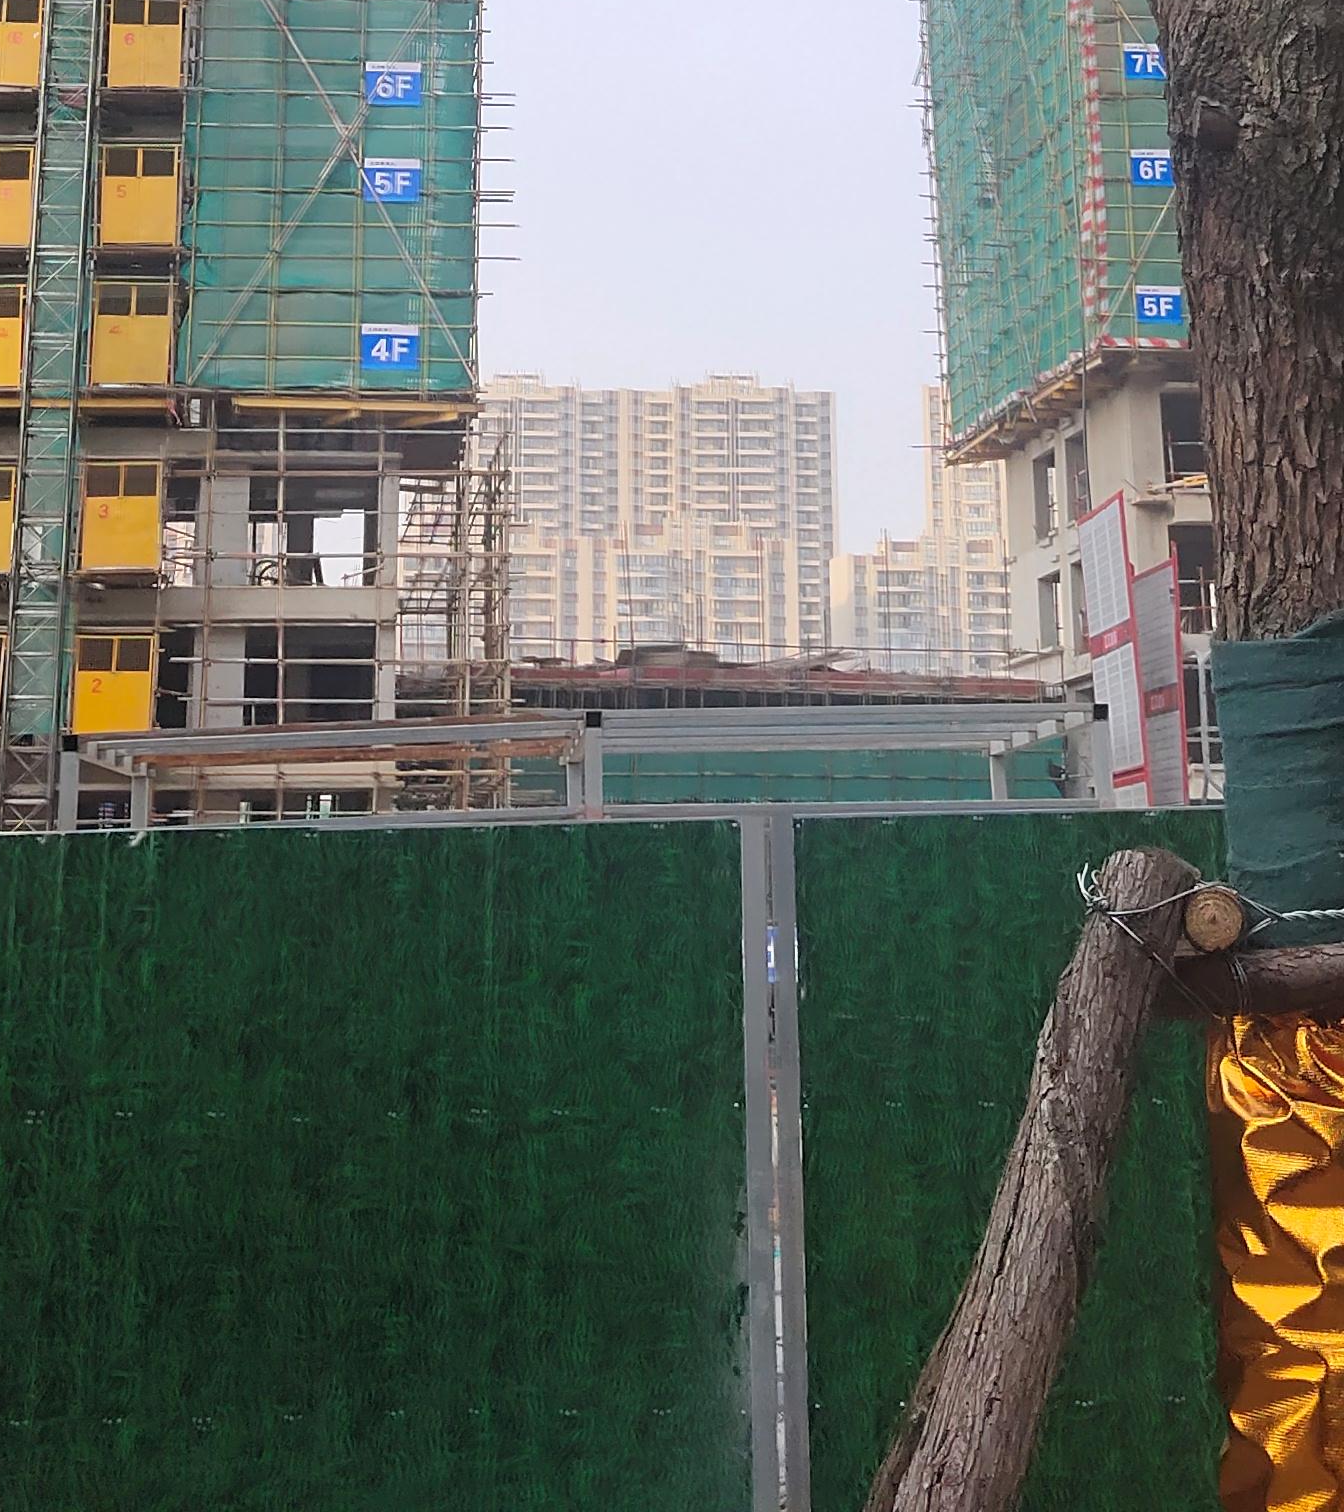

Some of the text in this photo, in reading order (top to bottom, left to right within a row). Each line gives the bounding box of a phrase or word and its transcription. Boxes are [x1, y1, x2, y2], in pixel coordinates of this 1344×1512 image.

[123, 32, 135, 46] 6
[1131, 54, 1162, 73] 7F
[376, 74, 412, 99] 6F
[1139, 160, 1168, 180] 6F
[116, 184, 127, 199] 5
[374, 171, 412, 196] 5F
[1143, 297, 1174, 317] 5F
[371, 338, 410, 362] 4F
[99, 503, 110, 519] 3
[91, 677, 103, 694] 2
